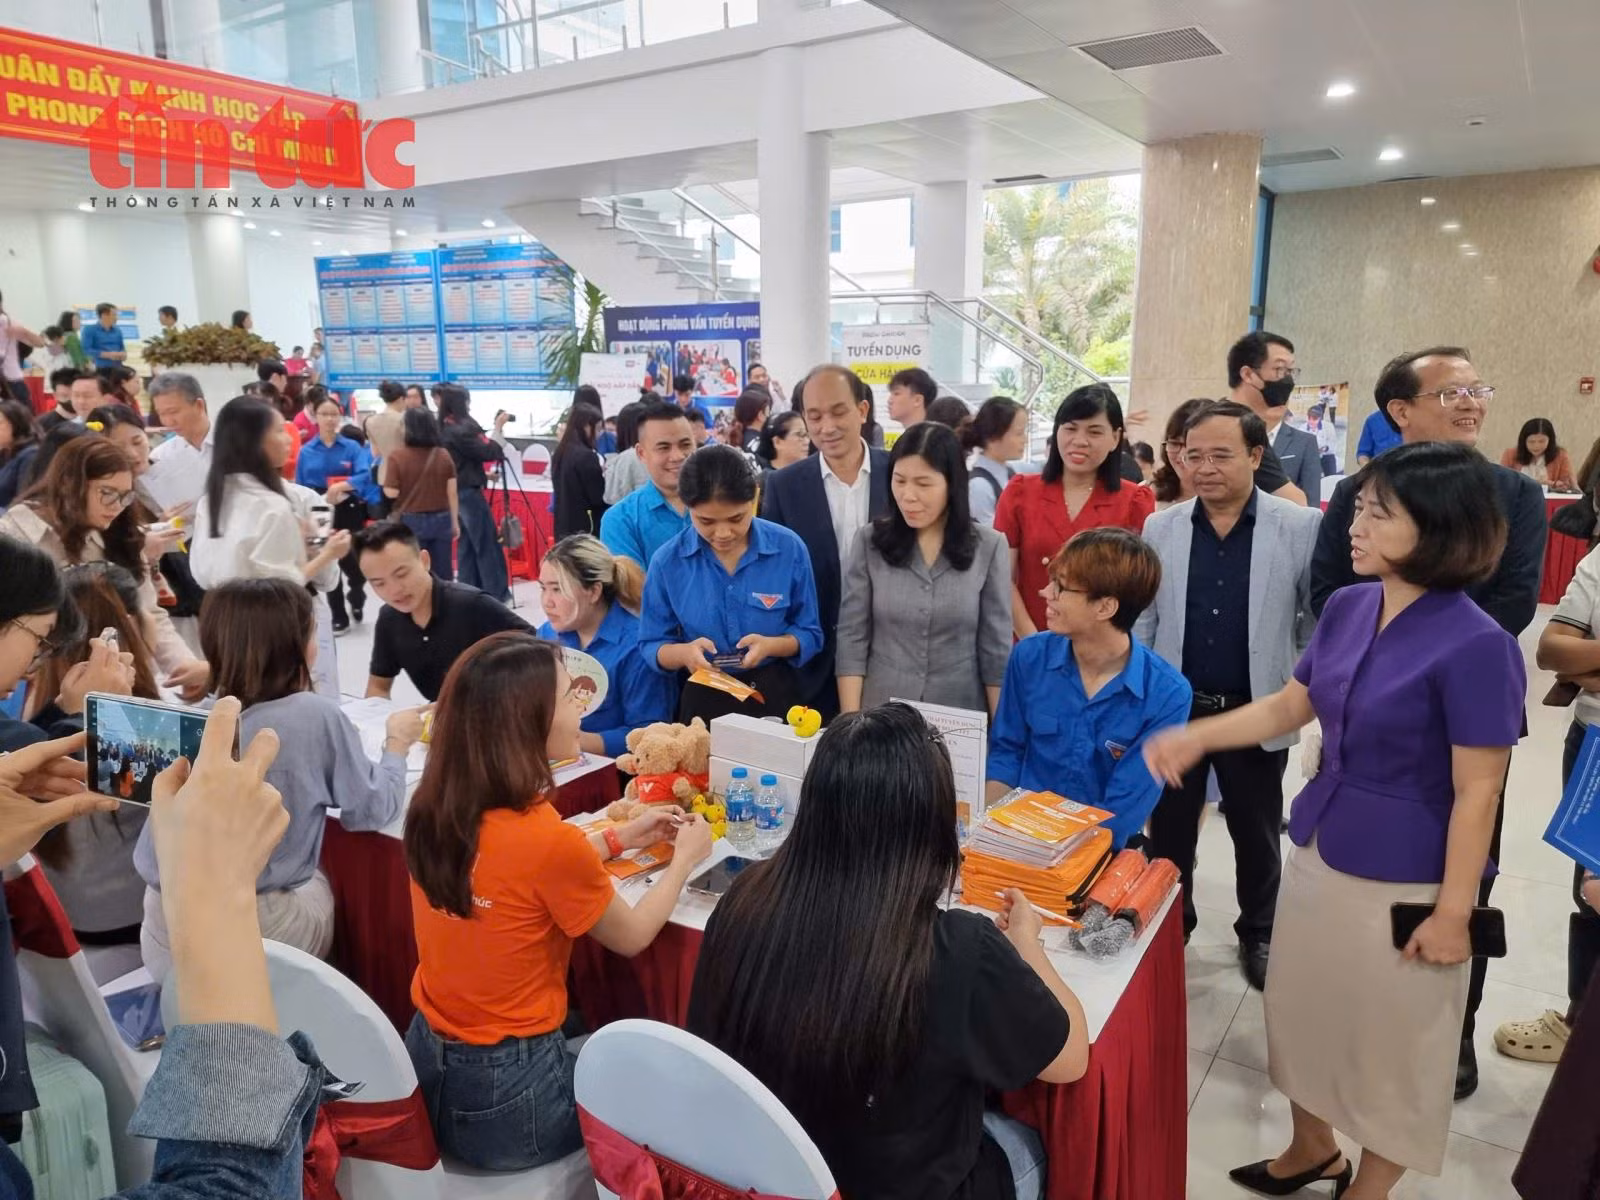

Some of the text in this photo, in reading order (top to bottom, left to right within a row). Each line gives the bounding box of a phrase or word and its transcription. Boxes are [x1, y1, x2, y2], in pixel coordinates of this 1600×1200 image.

[213, 96, 259, 124] HỌC
[847, 341, 922, 359] TUYỂN DỤNG
